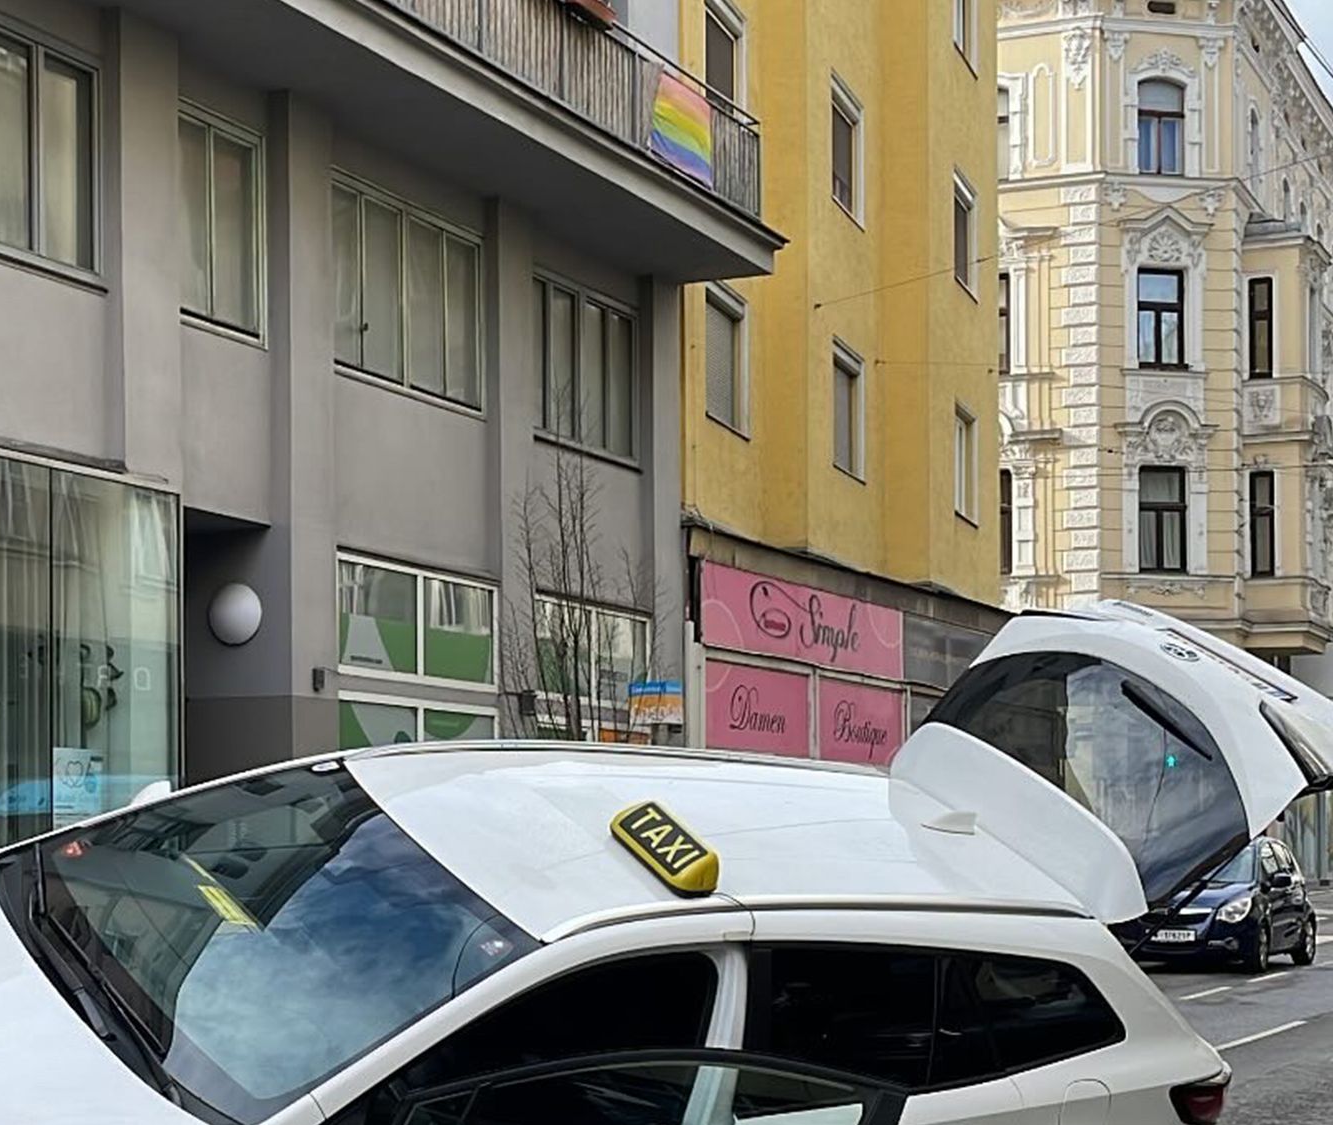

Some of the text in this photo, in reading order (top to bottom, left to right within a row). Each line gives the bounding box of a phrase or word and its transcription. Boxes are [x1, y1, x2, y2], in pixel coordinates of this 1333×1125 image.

[799, 594, 861, 663] Simple
[729, 684, 786, 734] Damen
[833, 700, 888, 760] Boutique
[631, 807, 700, 869] TAXI
